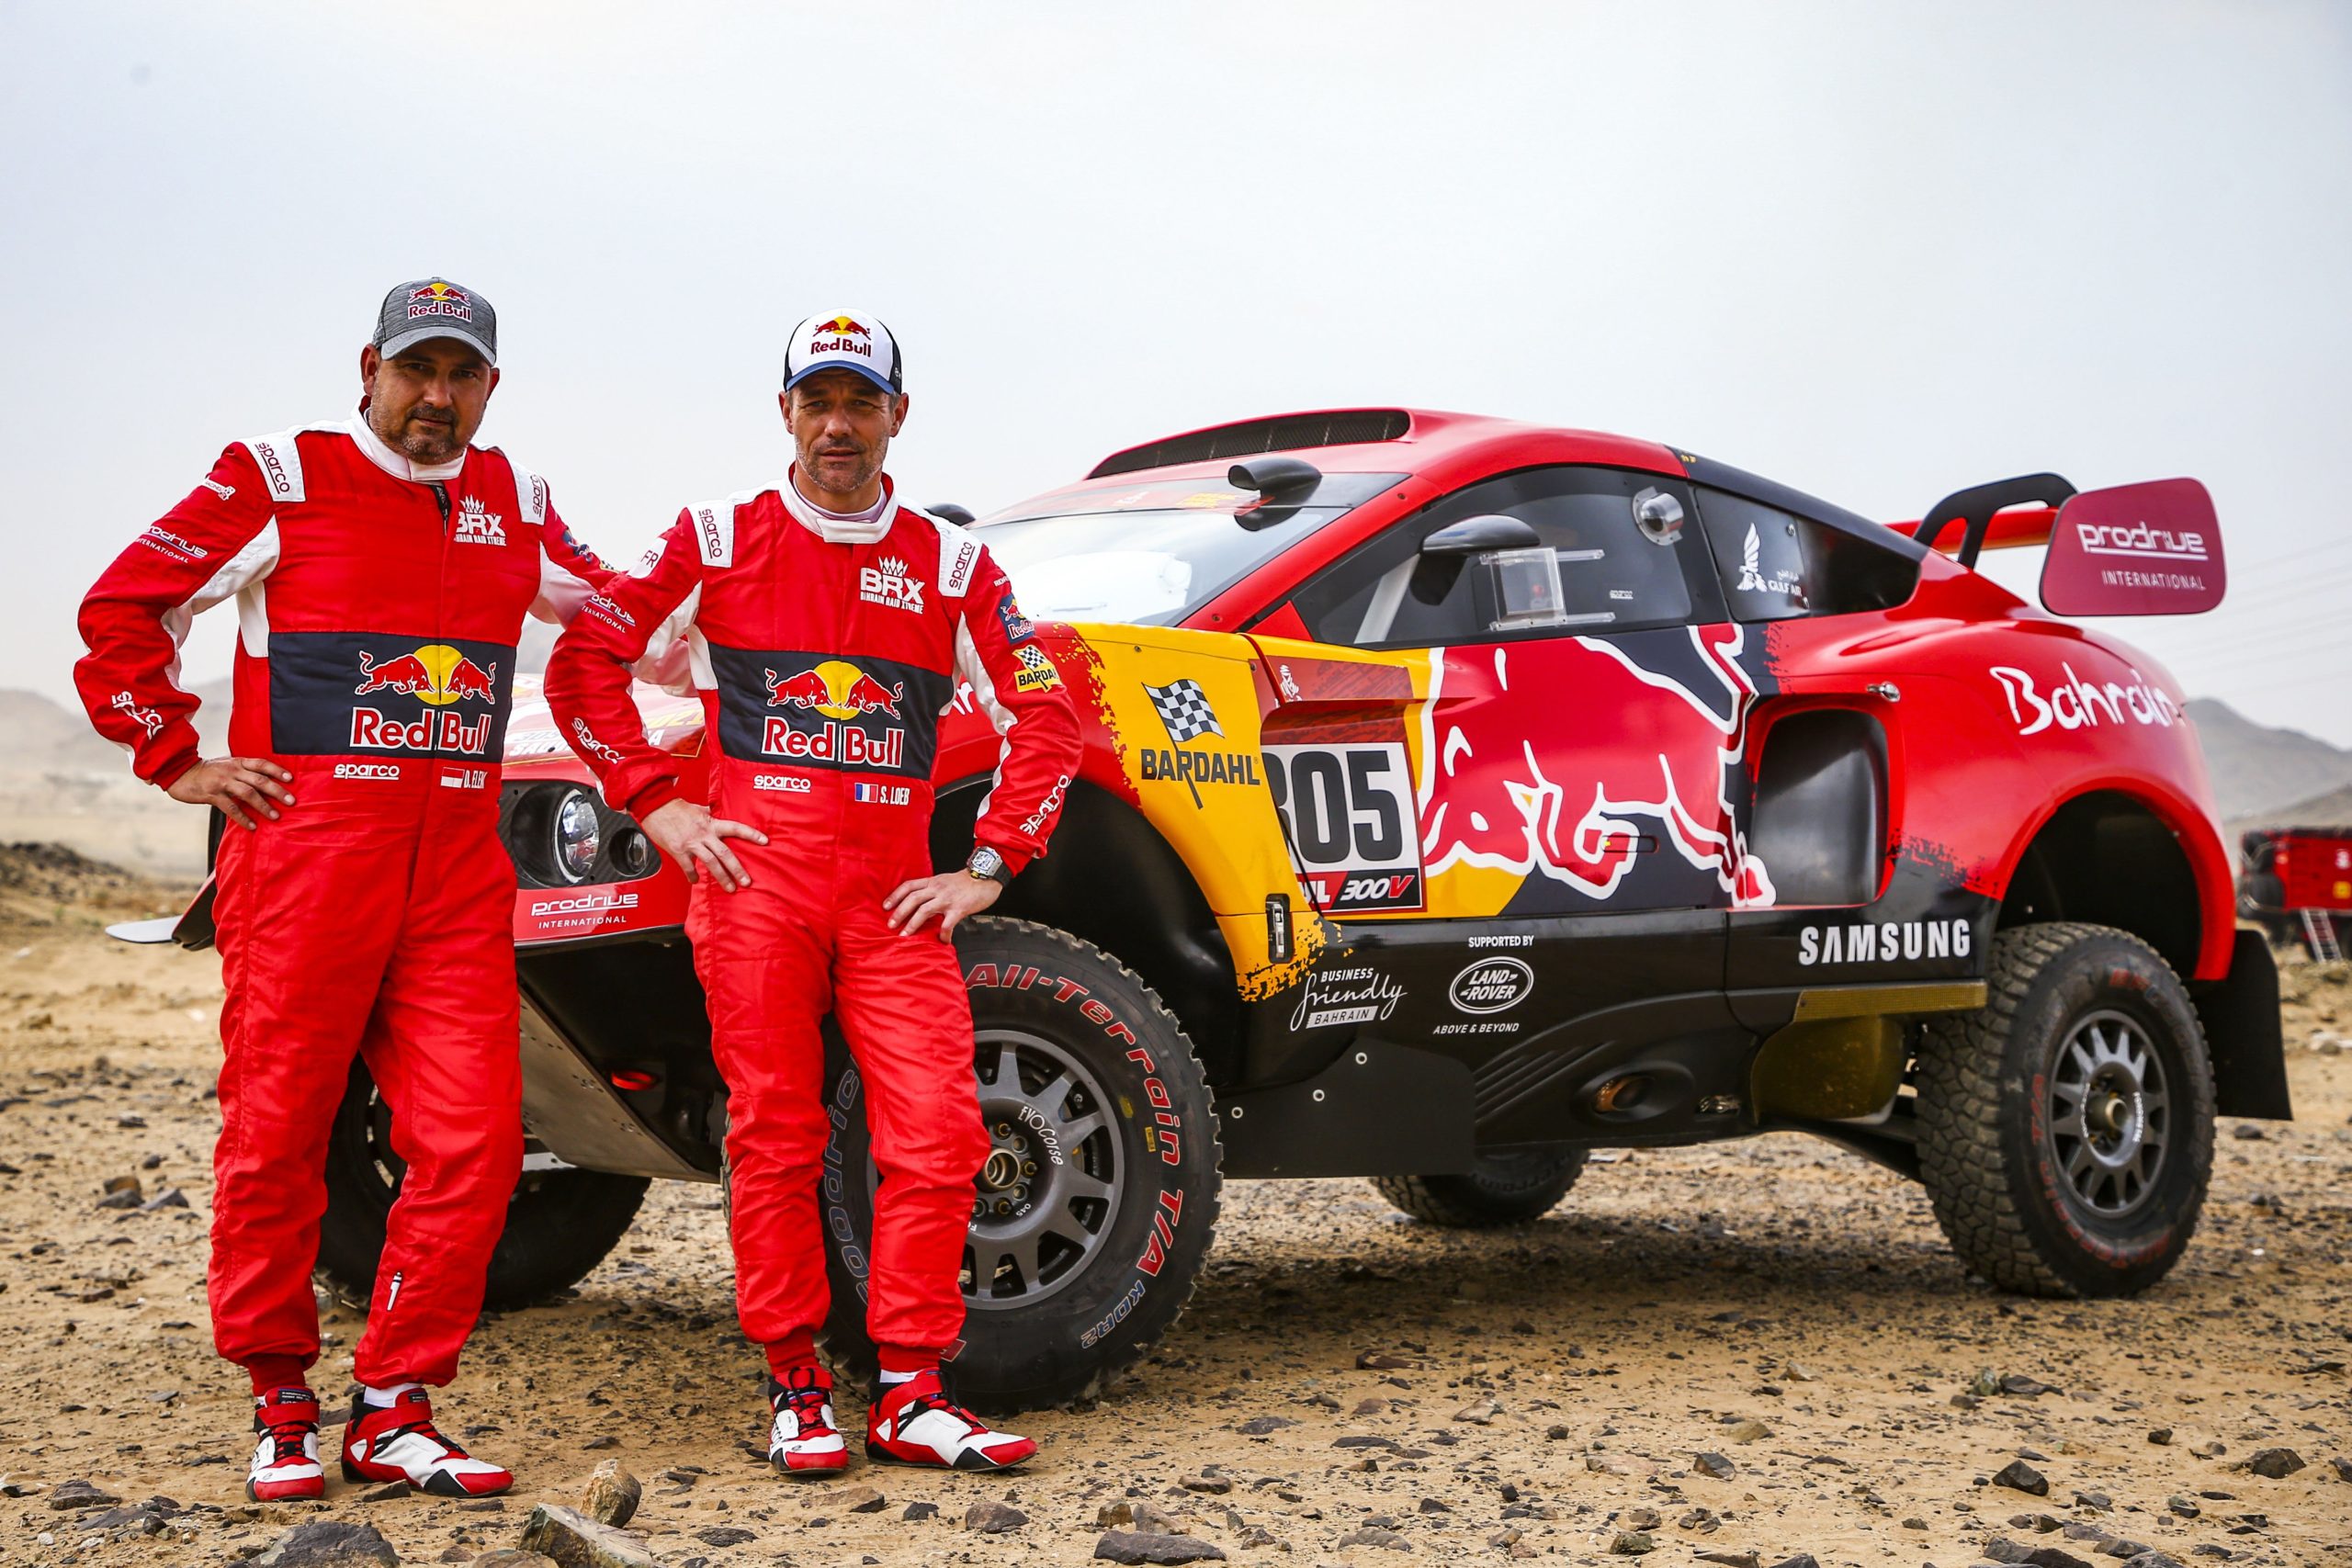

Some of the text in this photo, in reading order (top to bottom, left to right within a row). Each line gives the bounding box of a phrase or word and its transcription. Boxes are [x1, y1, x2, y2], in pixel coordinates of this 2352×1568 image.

[408, 301, 471, 322] Red Bull
[810, 337, 871, 357] Red Bull
[254, 443, 290, 494] sparco
[698, 508, 722, 559] sparco
[949, 541, 976, 591] sparco
[860, 567, 925, 605] BRX
[2101, 570, 2207, 591] INTERNATIONAL
[350, 707, 435, 750] Red
[438, 711, 492, 755] Bull
[761, 716, 905, 768] Red Bull
[334, 763, 400, 780] sparco
[1140, 749, 1261, 786] BARDAHL
[753, 774, 810, 792] sparco
[879, 785, 910, 806] S. LOEB
[1340, 874, 1416, 901] 300V
[538, 915, 628, 929] INTERNATIONAL
[1468, 935, 1534, 948] SUPPORTED BY
[1798, 919, 1971, 965] SAMSUNG
[1320, 967, 1374, 983] BUSINESS
[1290, 972, 1408, 1032] friendly
[1315, 1009, 1369, 1025] BAHRAIN
[1432, 1022, 1520, 1035] ABOVE & BEYOND
[965, 964, 1181, 1166] All-Terrain
